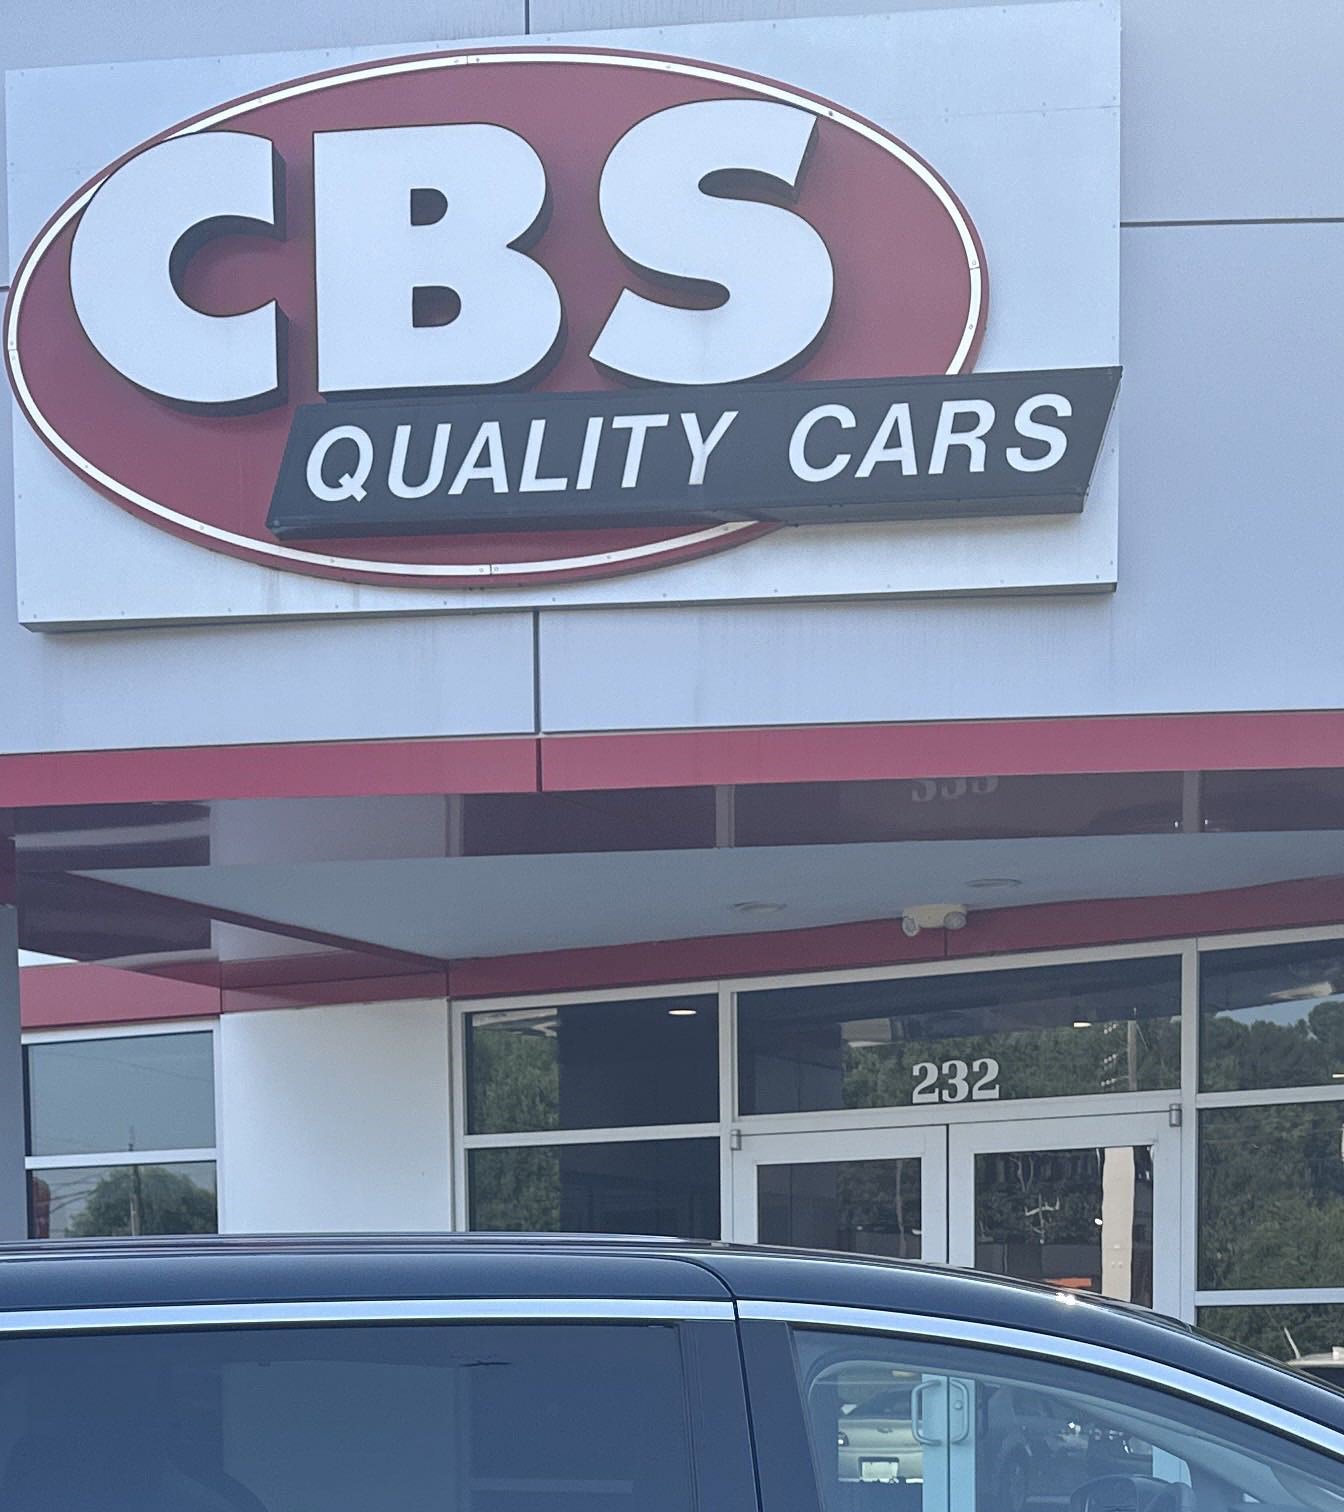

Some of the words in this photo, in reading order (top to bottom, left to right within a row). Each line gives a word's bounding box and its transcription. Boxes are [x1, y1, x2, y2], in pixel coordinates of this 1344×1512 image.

[69, 97, 836, 405] CBS
[304, 409, 738, 503] QUALITY
[787, 393, 1074, 482] CARS
[912, 1057, 1000, 1105] 232
